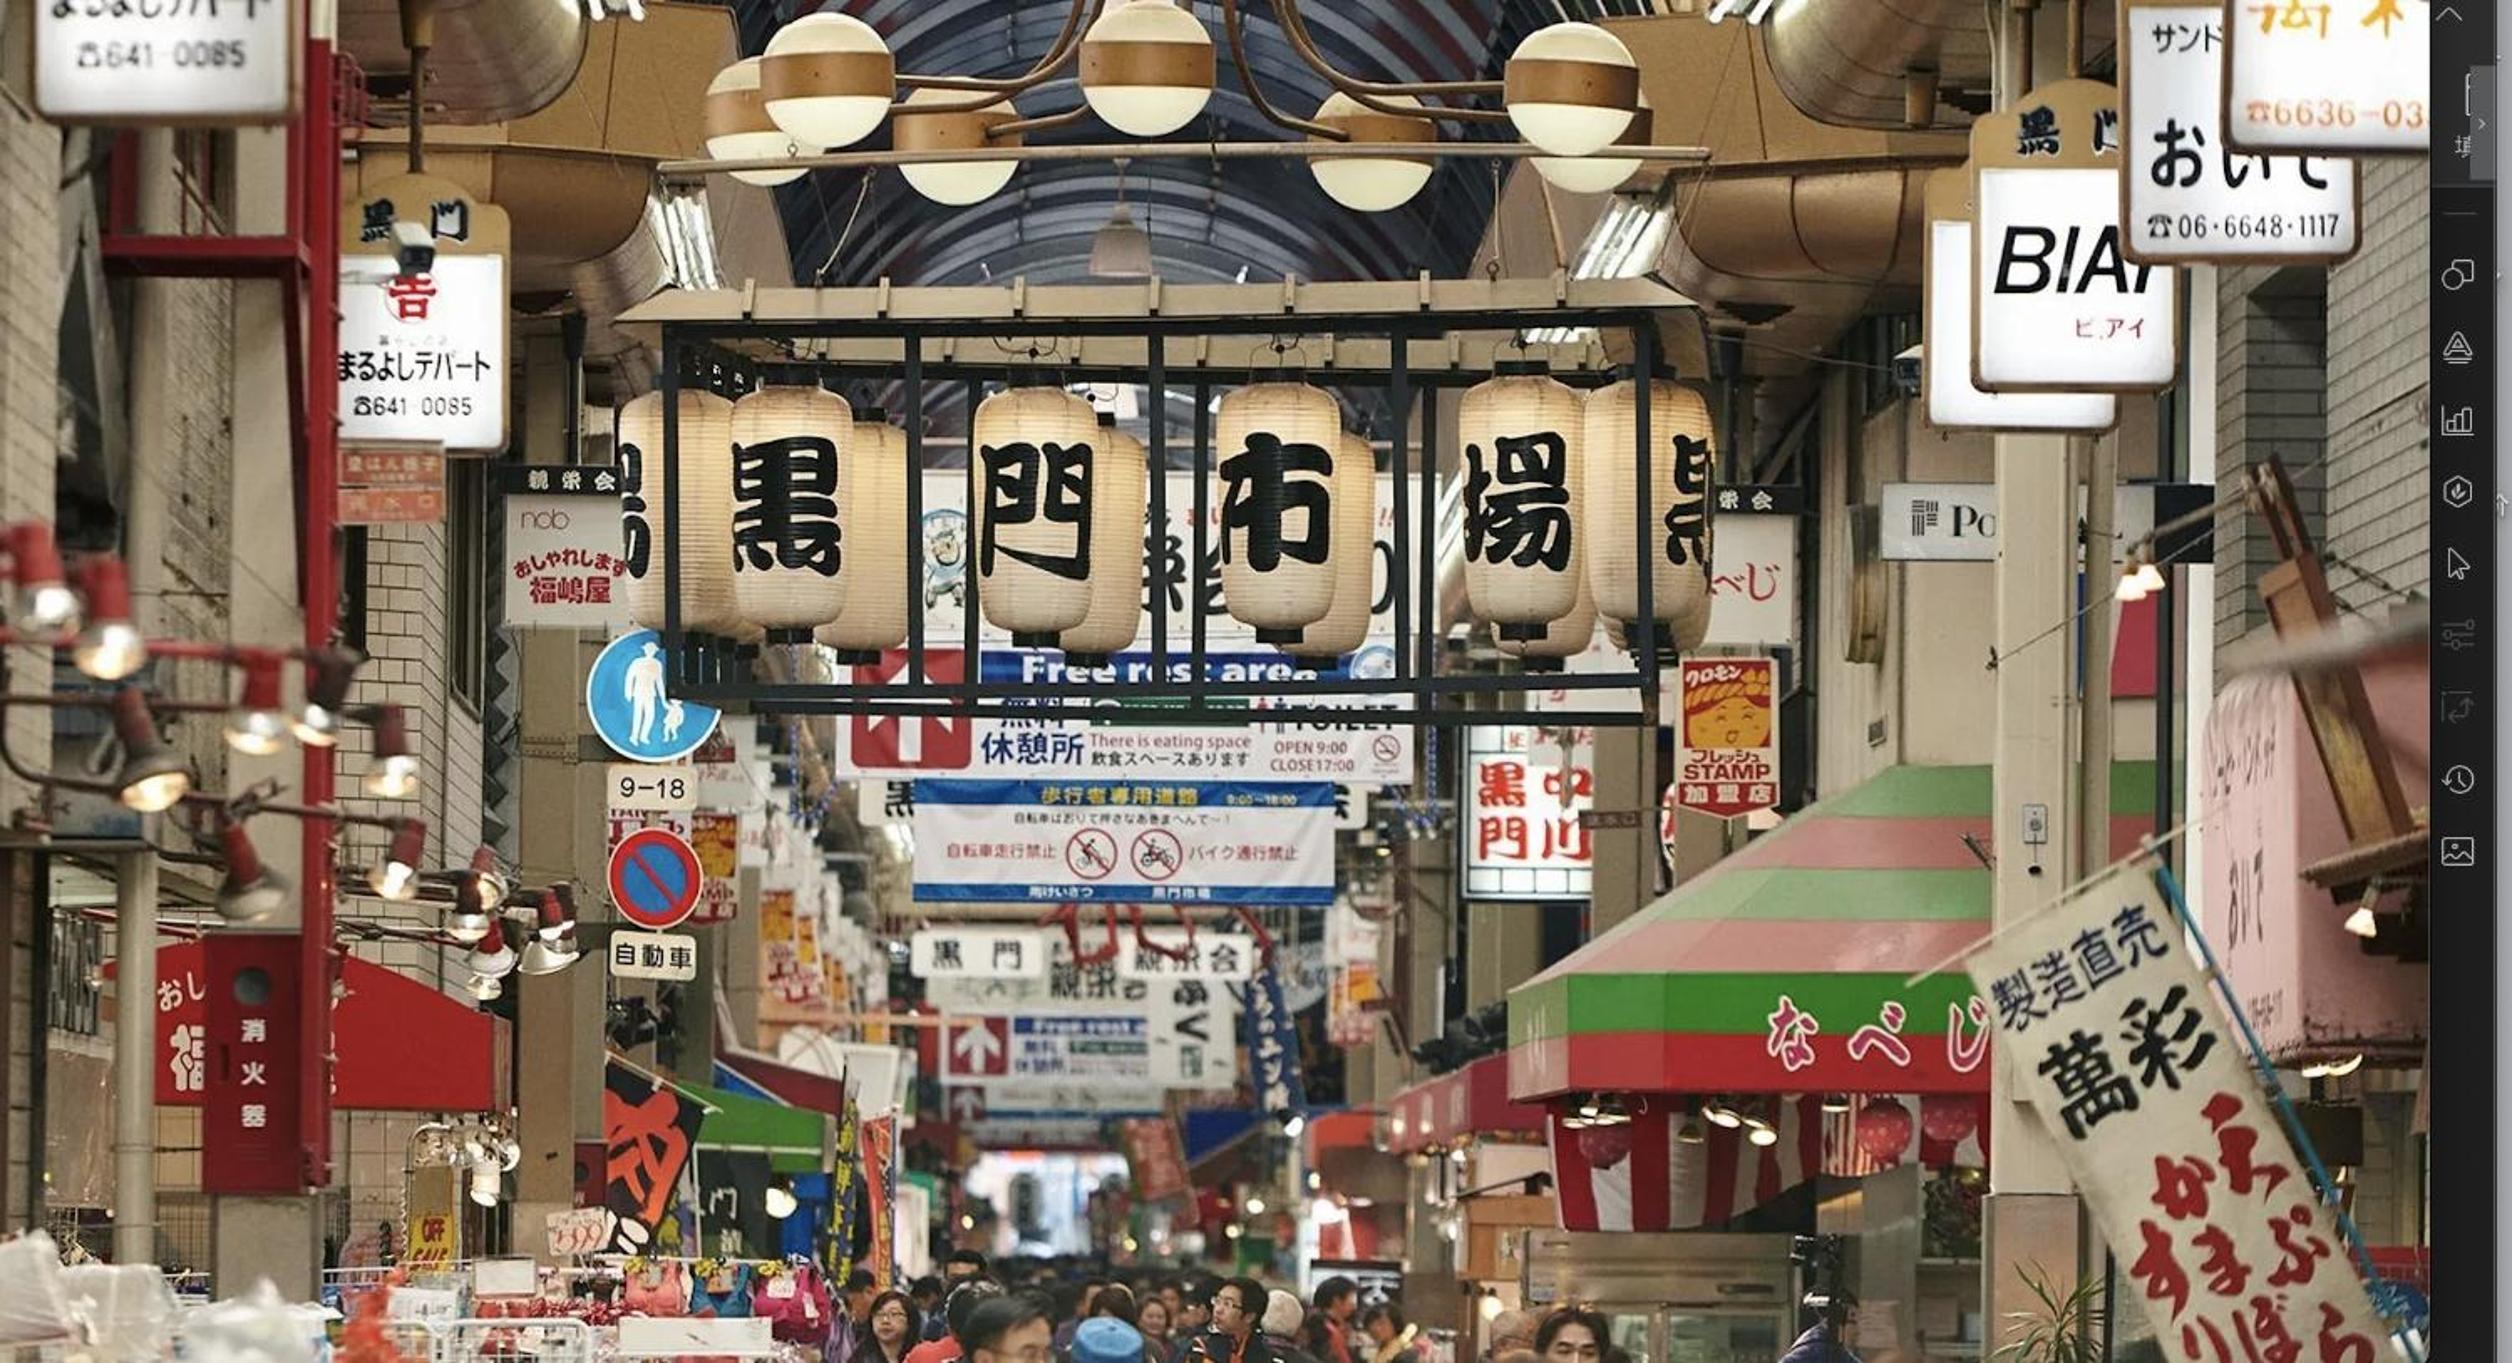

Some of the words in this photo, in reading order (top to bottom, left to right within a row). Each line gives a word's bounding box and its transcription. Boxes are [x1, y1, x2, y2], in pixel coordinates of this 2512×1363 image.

[106, 41, 152, 68] 641
[174, 39, 246, 68] 0085
[361, 198, 469, 242] 黒門
[373, 396, 407, 416] 641
[421, 396, 473, 416] 0085
[731, 436, 841, 577] 黒
[979, 442, 1093, 581] 門
[1219, 432, 1333, 572] 市
[1463, 432, 1572, 572] 場
[520, 509, 570, 530] nob
[529, 576, 612, 604] 福嶋屋
[1022, 655, 1116, 684] Free
[981, 732, 1084, 765] 休憩所
[1090, 733, 1134, 747] There
[1137, 733, 1150, 747] is
[1154, 733, 1200, 751] eating
[1206, 736, 1251, 751] space
[1274, 740, 1314, 755] OPEN
[1684, 764, 1770, 781] STAMP
[614, 944, 692, 969] 自動車
[1990, 904, 2169, 1032] 製造直売
[1769, 996, 1990, 1071] なべじ
[241, 1019, 267, 1128] 消火器
